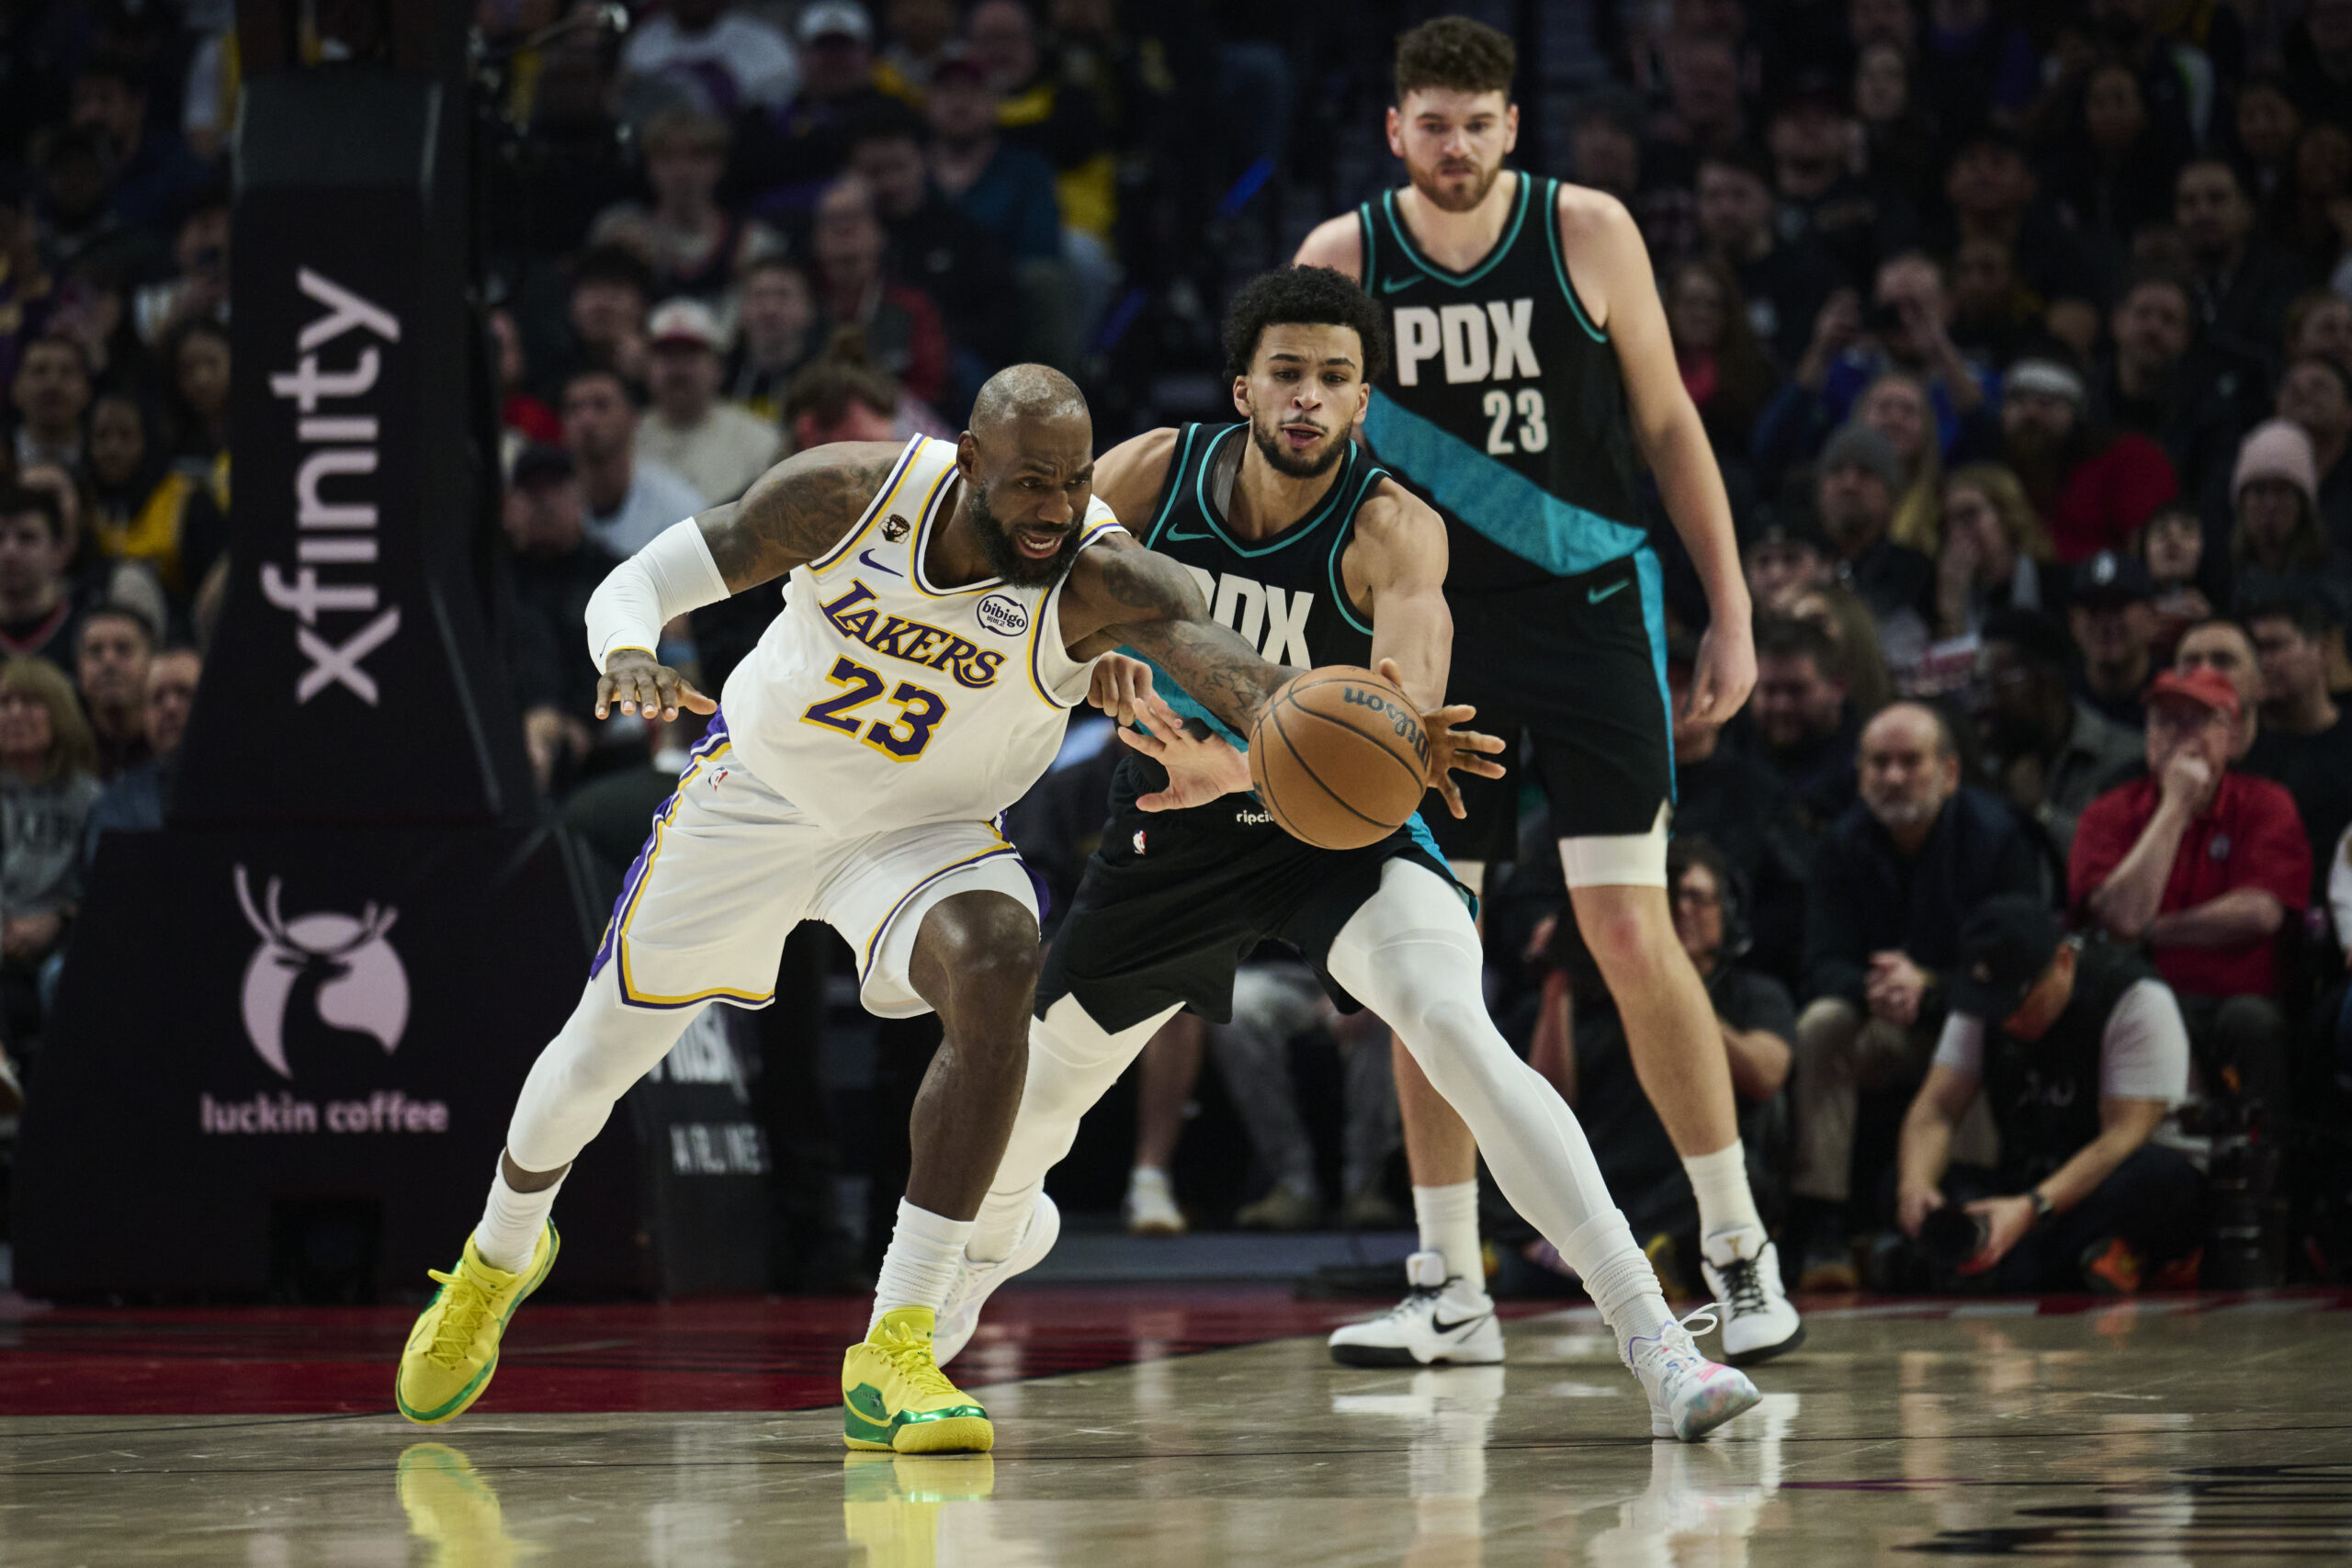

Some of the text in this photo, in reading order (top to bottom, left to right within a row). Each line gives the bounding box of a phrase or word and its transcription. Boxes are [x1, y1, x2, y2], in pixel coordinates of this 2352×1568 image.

[1393, 298, 1542, 387] PDX
[1482, 388, 1549, 456] 23
[260, 265, 402, 706] xfinity
[817, 577, 1008, 689] LAKERS
[981, 600, 1025, 628] bibigo
[798, 654, 950, 763] 23
[200, 1090, 449, 1134] luckin coffee
